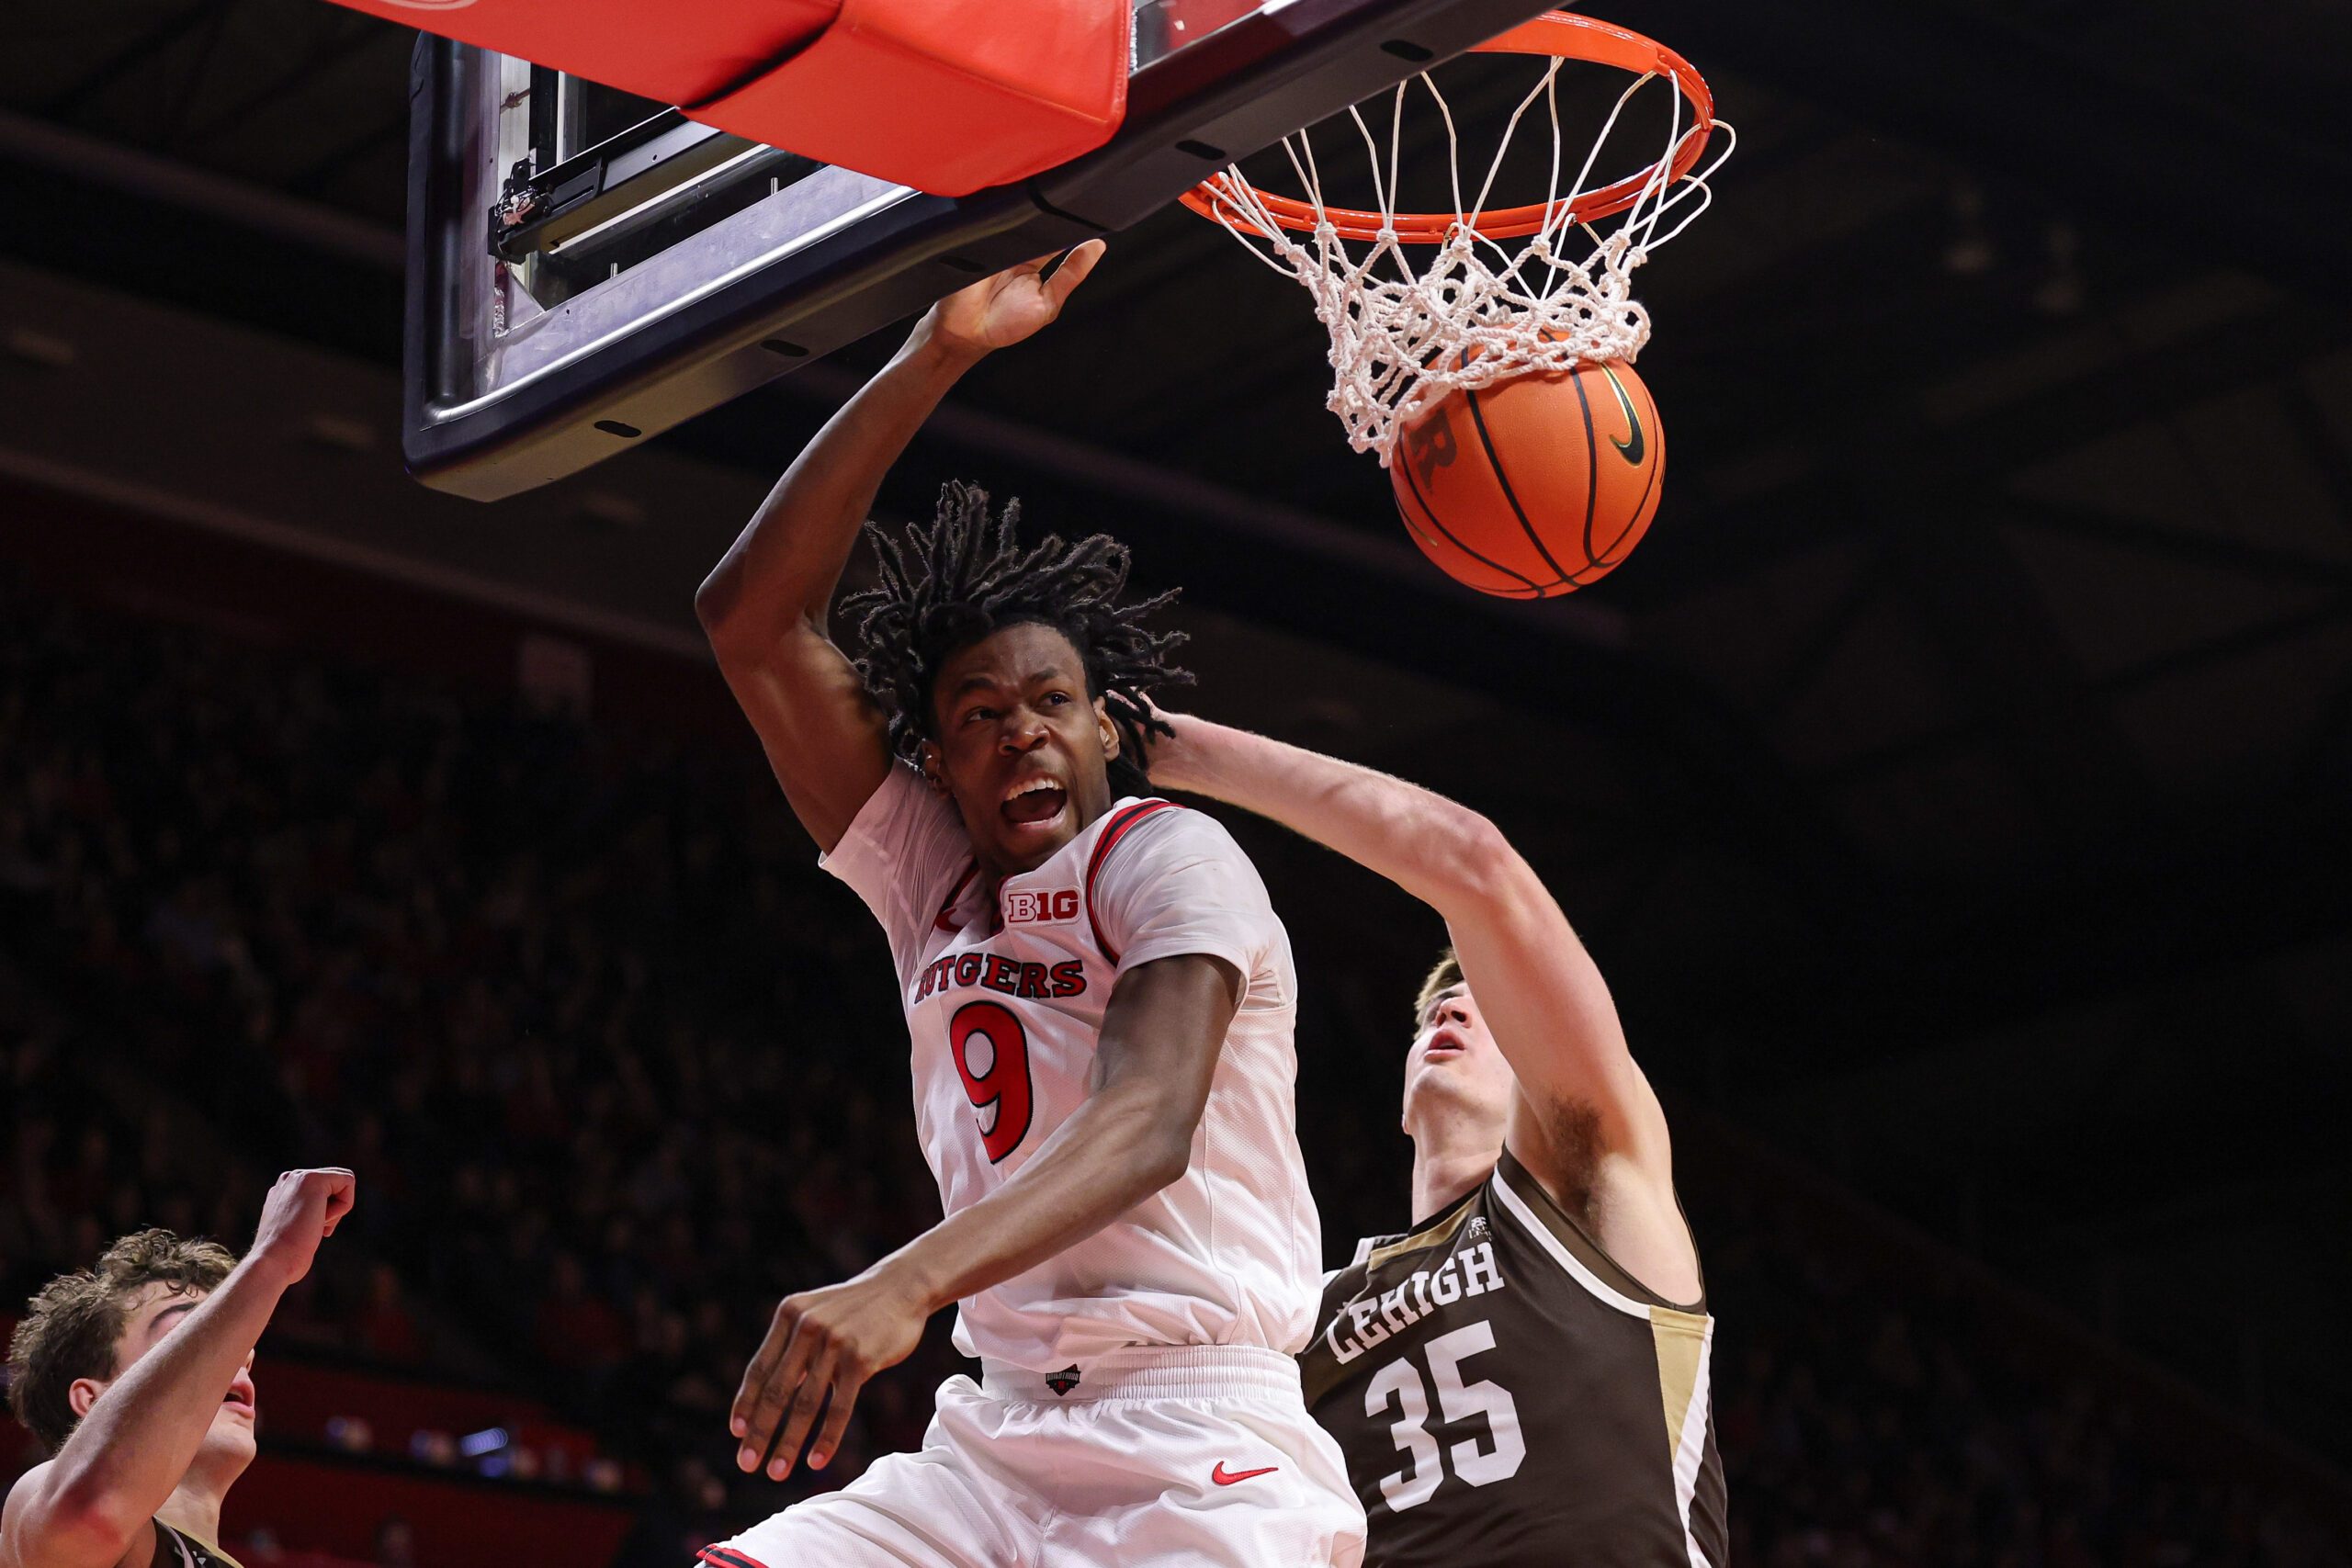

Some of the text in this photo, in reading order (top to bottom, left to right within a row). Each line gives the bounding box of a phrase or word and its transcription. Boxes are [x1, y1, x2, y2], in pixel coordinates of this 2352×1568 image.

[1410, 408, 1457, 491] R
[950, 999, 1033, 1164] 9
[1327, 1241, 1505, 1365] LEHIGH
[1364, 1320, 1526, 1513] 35
